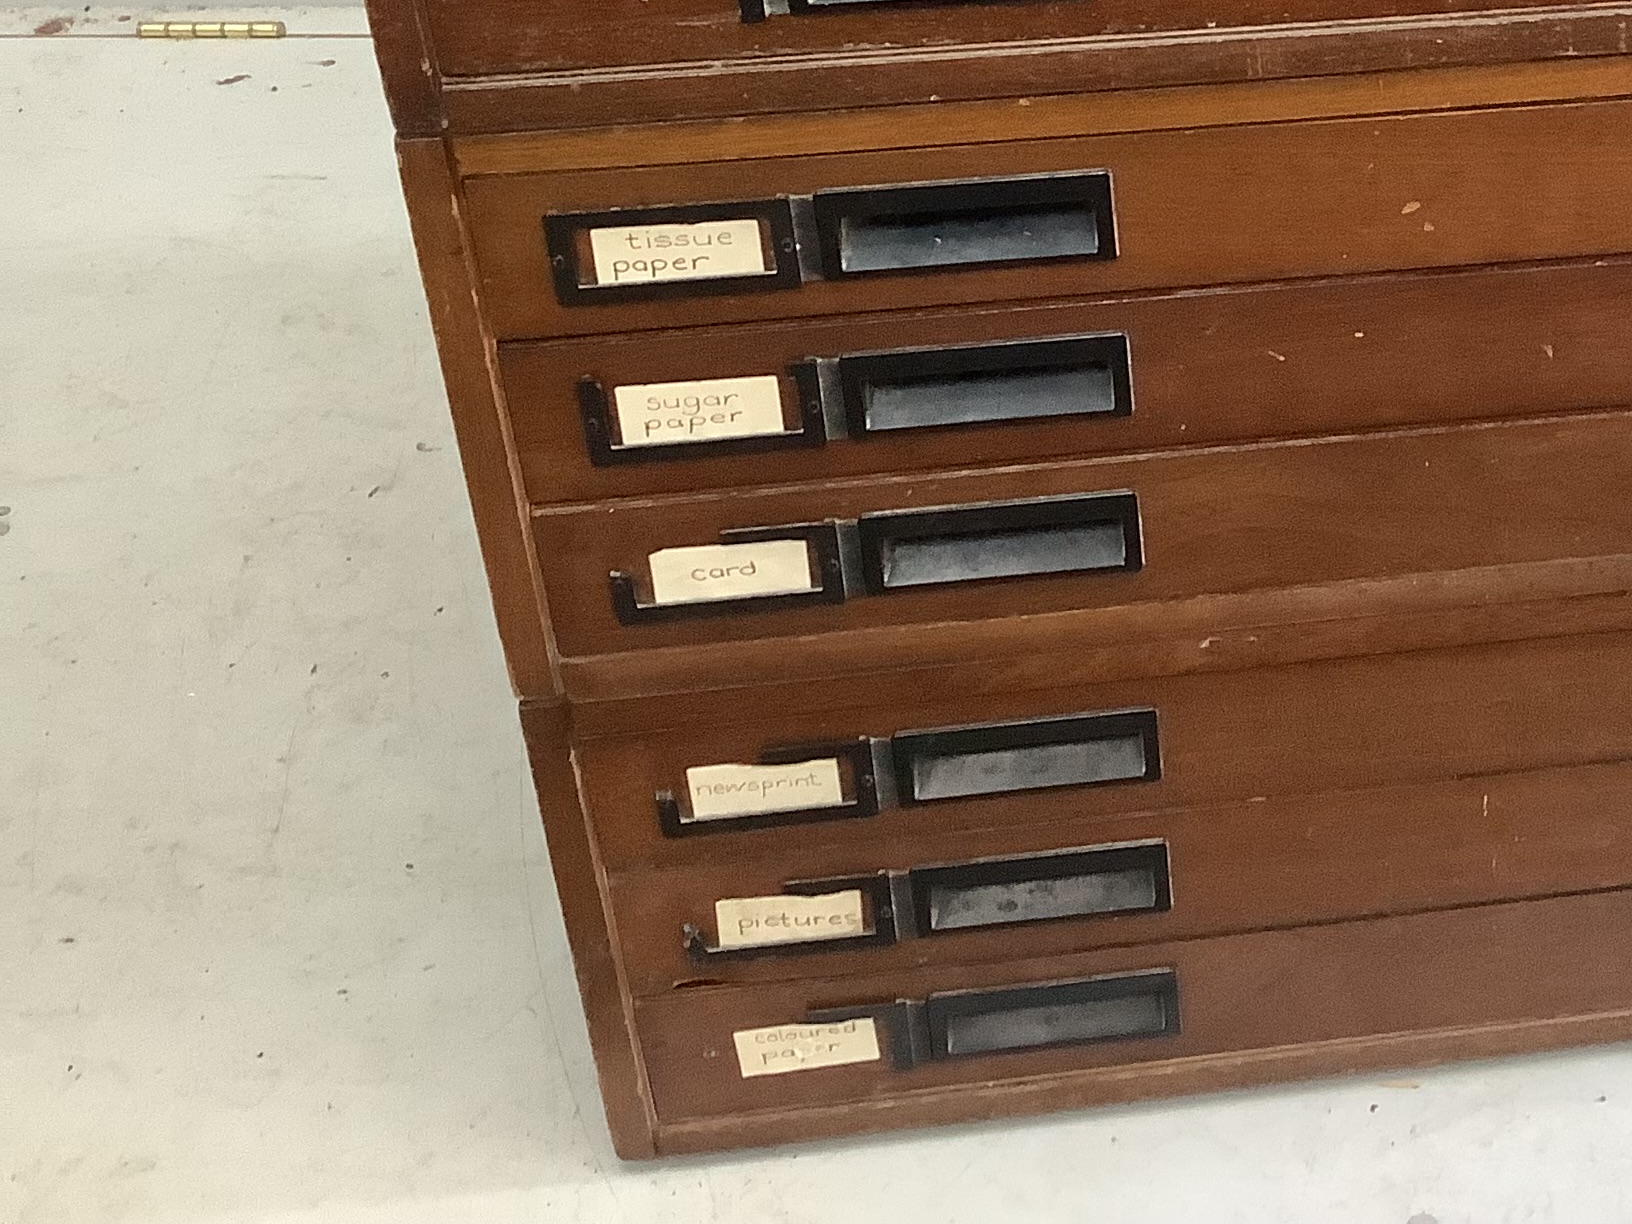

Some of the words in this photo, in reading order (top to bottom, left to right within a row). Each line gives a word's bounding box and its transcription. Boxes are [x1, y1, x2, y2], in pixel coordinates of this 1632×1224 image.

[624, 230, 733, 250] tissue
[612, 255, 710, 281] paper
[646, 393, 739, 416] sugar
[644, 410, 743, 438] paper
[691, 560, 757, 581] card
[695, 772, 823, 799] newsprint
[737, 911, 860, 936] pictures
[754, 1021, 857, 1044] coloured
